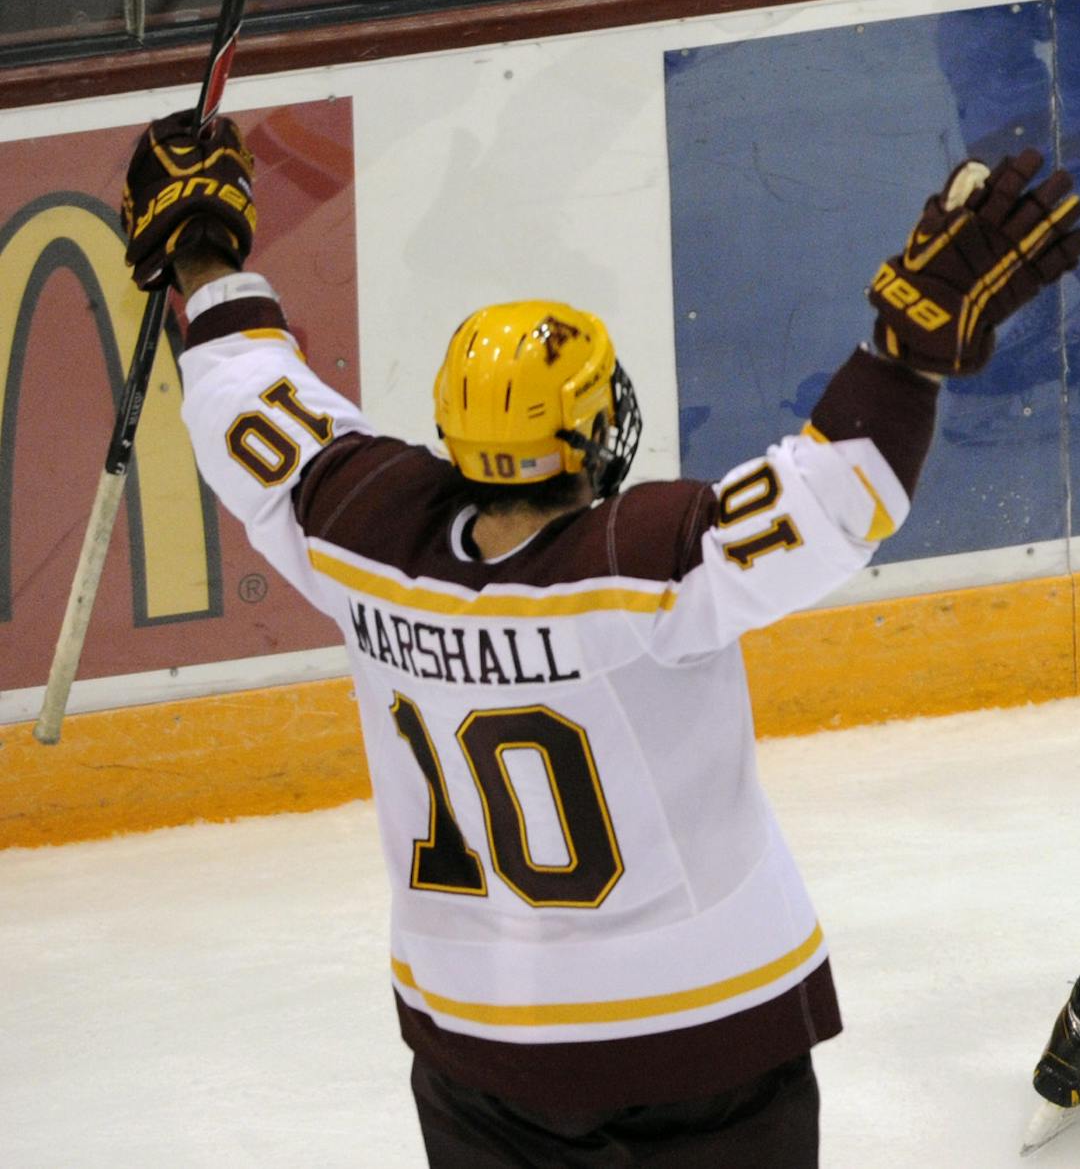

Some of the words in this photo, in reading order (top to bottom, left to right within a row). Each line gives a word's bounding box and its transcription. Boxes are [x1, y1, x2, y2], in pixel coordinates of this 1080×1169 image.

[224, 375, 335, 489] 10
[479, 451, 515, 479] 10
[719, 461, 805, 571] 10
[349, 595, 581, 686] MARSHALL
[389, 689, 625, 909] 10
